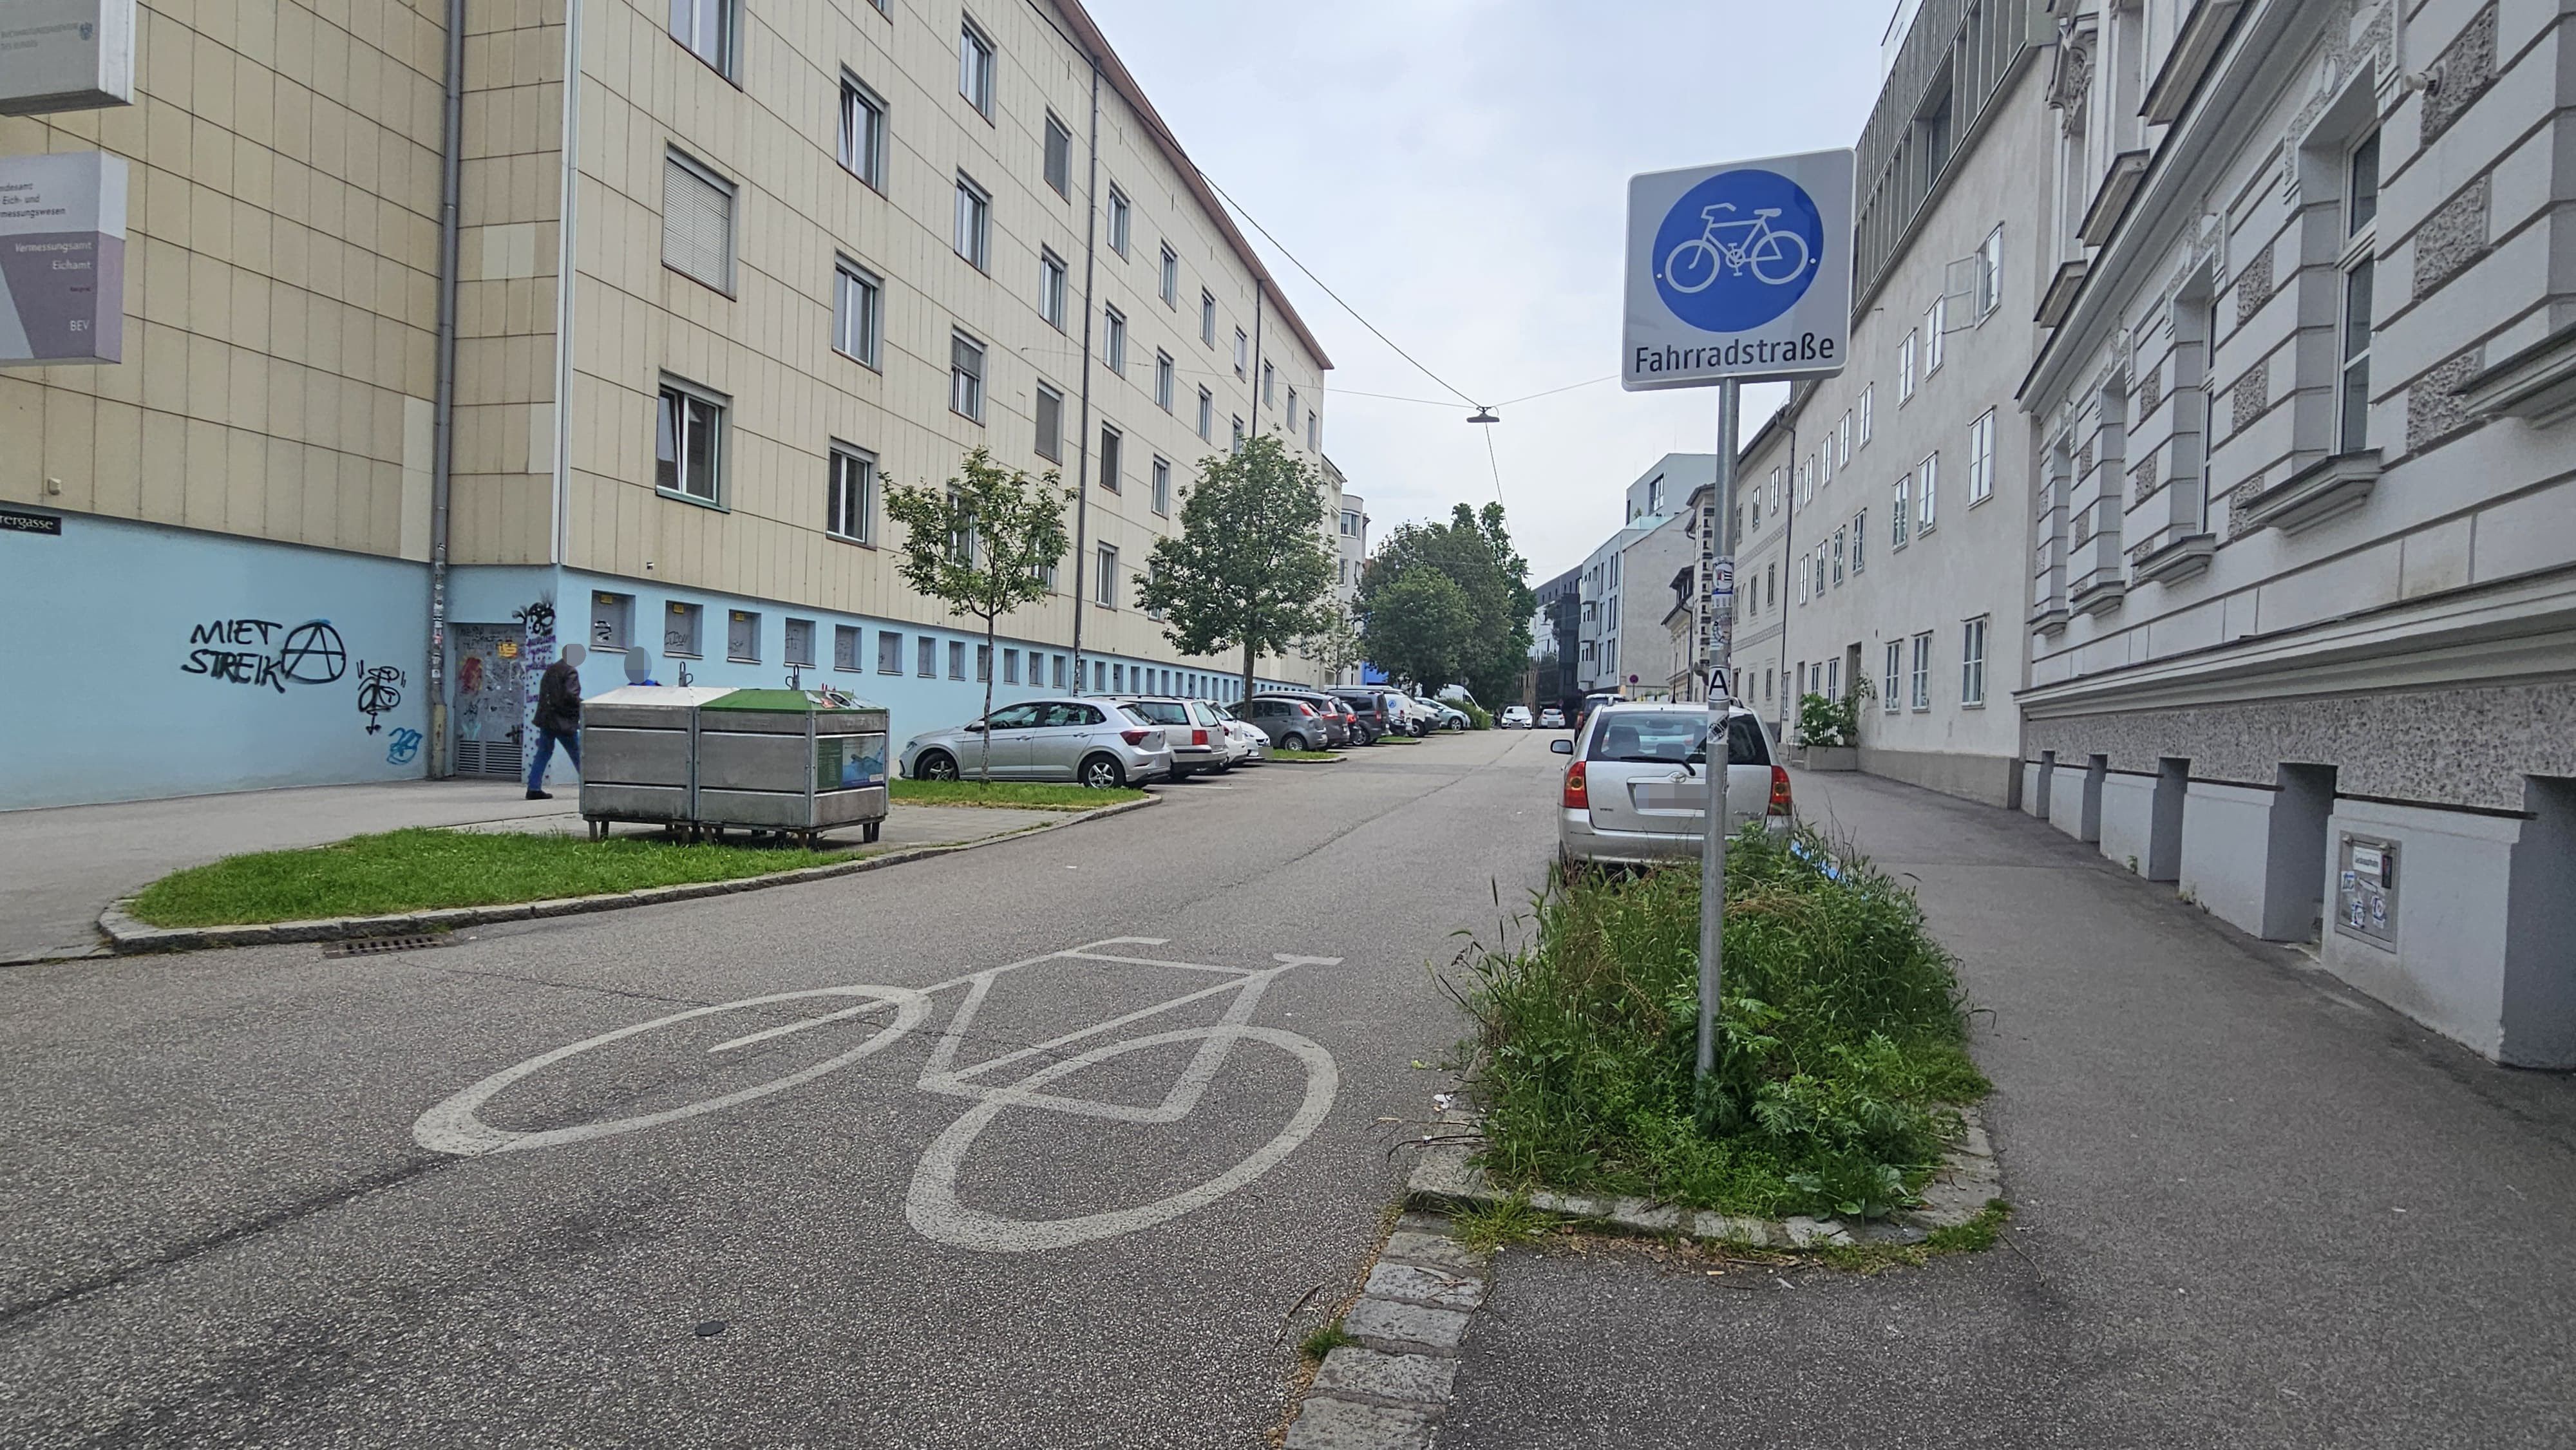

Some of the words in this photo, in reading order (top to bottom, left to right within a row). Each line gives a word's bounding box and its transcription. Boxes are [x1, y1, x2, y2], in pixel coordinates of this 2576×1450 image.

[24, 194, 40, 203] und
[15, 241, 91, 253] Vermessungsamt
[52, 259, 91, 270] Eichamt
[70, 319, 90, 332] BEV
[1636, 332, 1834, 373] Fahrradstraße
[190, 619, 283, 645] MIET
[180, 648, 285, 693] STREIK
[1709, 670, 1728, 696] A
